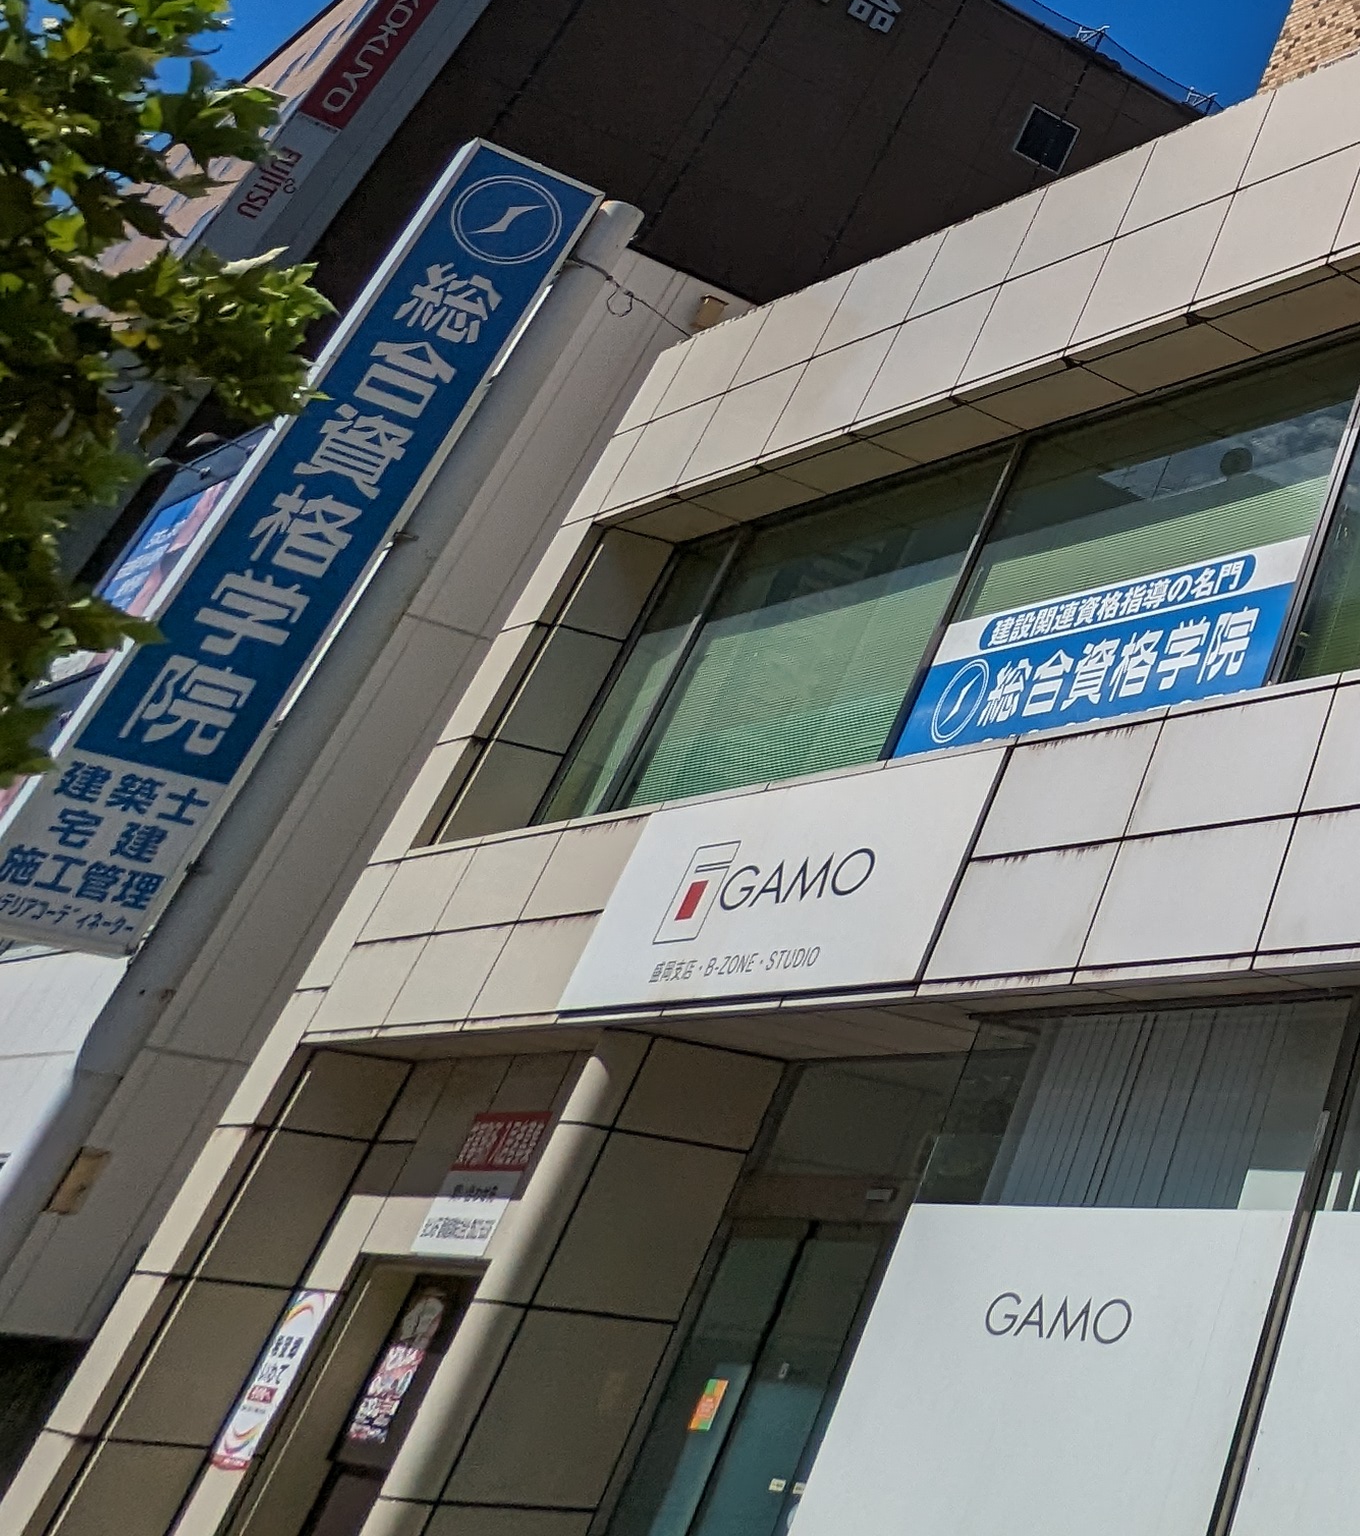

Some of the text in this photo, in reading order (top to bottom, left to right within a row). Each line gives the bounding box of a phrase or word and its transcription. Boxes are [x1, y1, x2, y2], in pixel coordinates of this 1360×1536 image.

[237, 146, 303, 220] FUJITSU
[119, 263, 505, 756] 総合資格学院
[988, 558, 1245, 646] 建設関連資格指導の名門
[977, 606, 1260, 727] 総合資格学院
[54, 761, 210, 826] 建築士
[0, 844, 167, 910] 施工管理
[720, 847, 876, 911] GAMO
[984, 1291, 1134, 1346] GAMO
